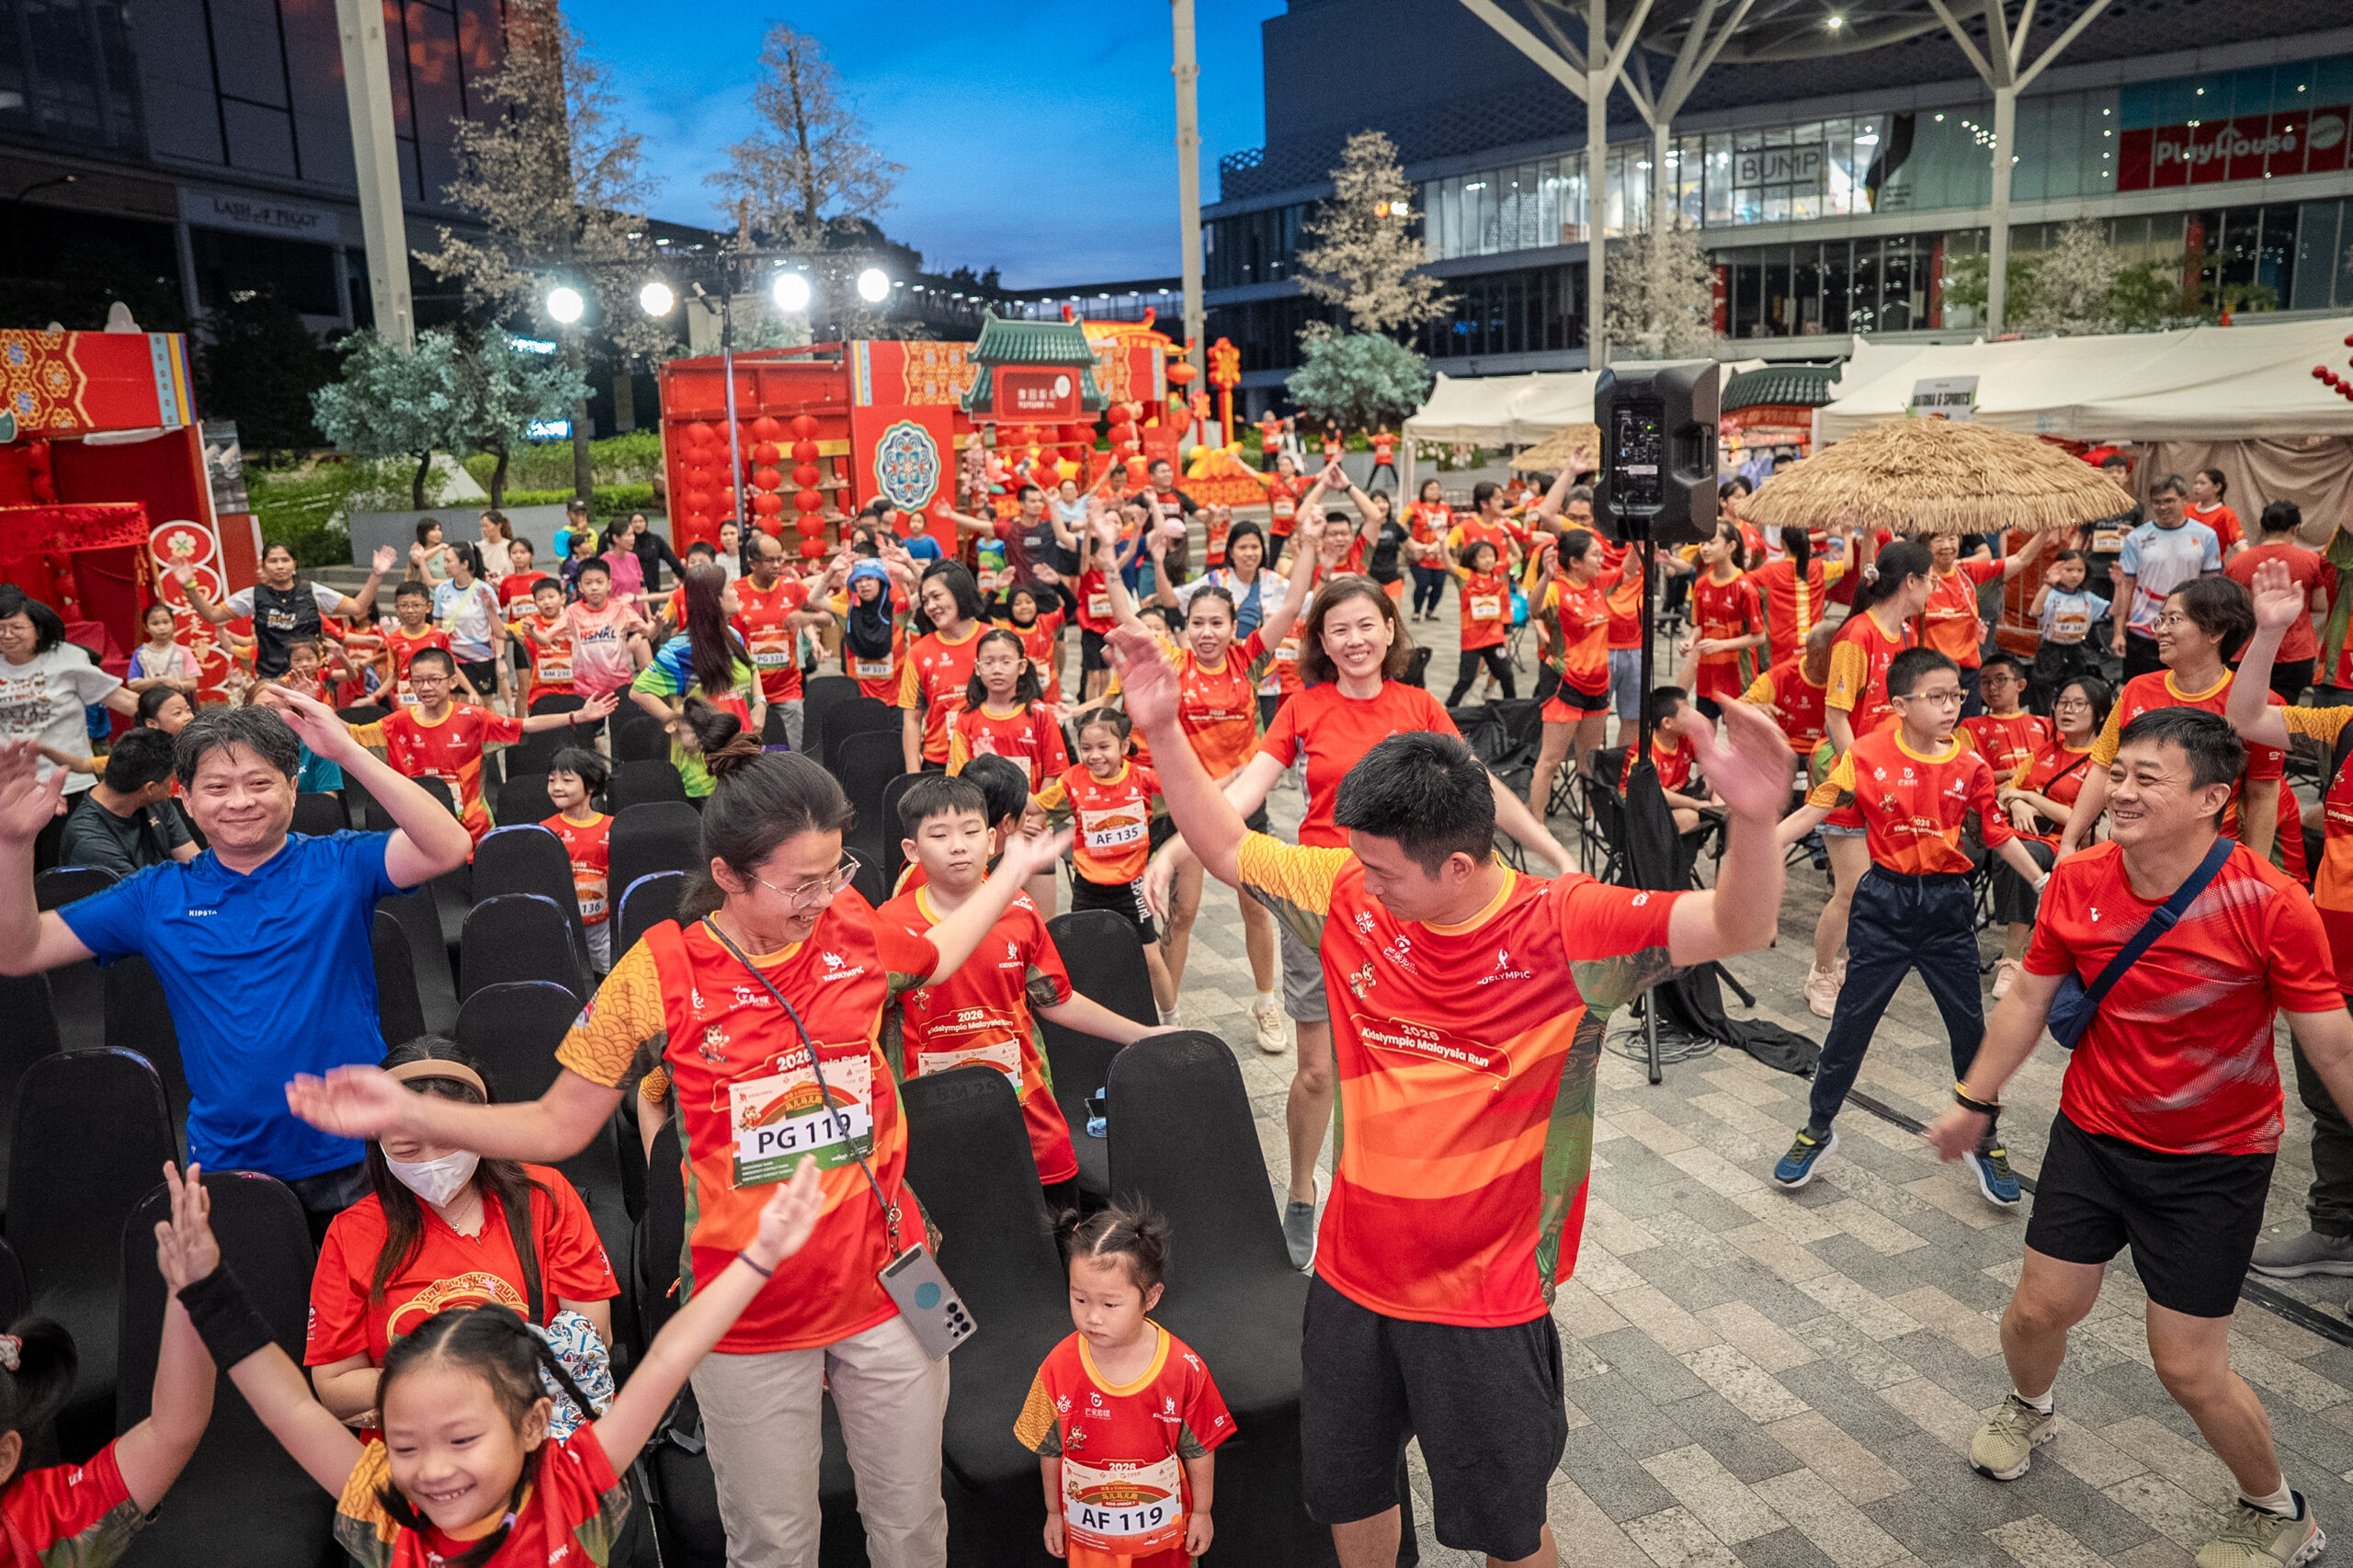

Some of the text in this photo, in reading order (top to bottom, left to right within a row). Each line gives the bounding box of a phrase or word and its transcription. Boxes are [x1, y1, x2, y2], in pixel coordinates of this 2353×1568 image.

[1742, 152, 1819, 181] BUMP
[1097, 827, 1139, 845] AF 135
[582, 902, 601, 914] 136
[957, 1009, 984, 1023] 2026
[1401, 1024, 1441, 1041] 2026
[1361, 1027, 1490, 1068] Kidslympic Malaysia Run
[776, 1049, 813, 1073] 2026
[758, 1126, 797, 1154] PG
[805, 1113, 851, 1143] 119
[1108, 1462, 1137, 1471] 2026
[1081, 1506, 1164, 1531] AF 119
